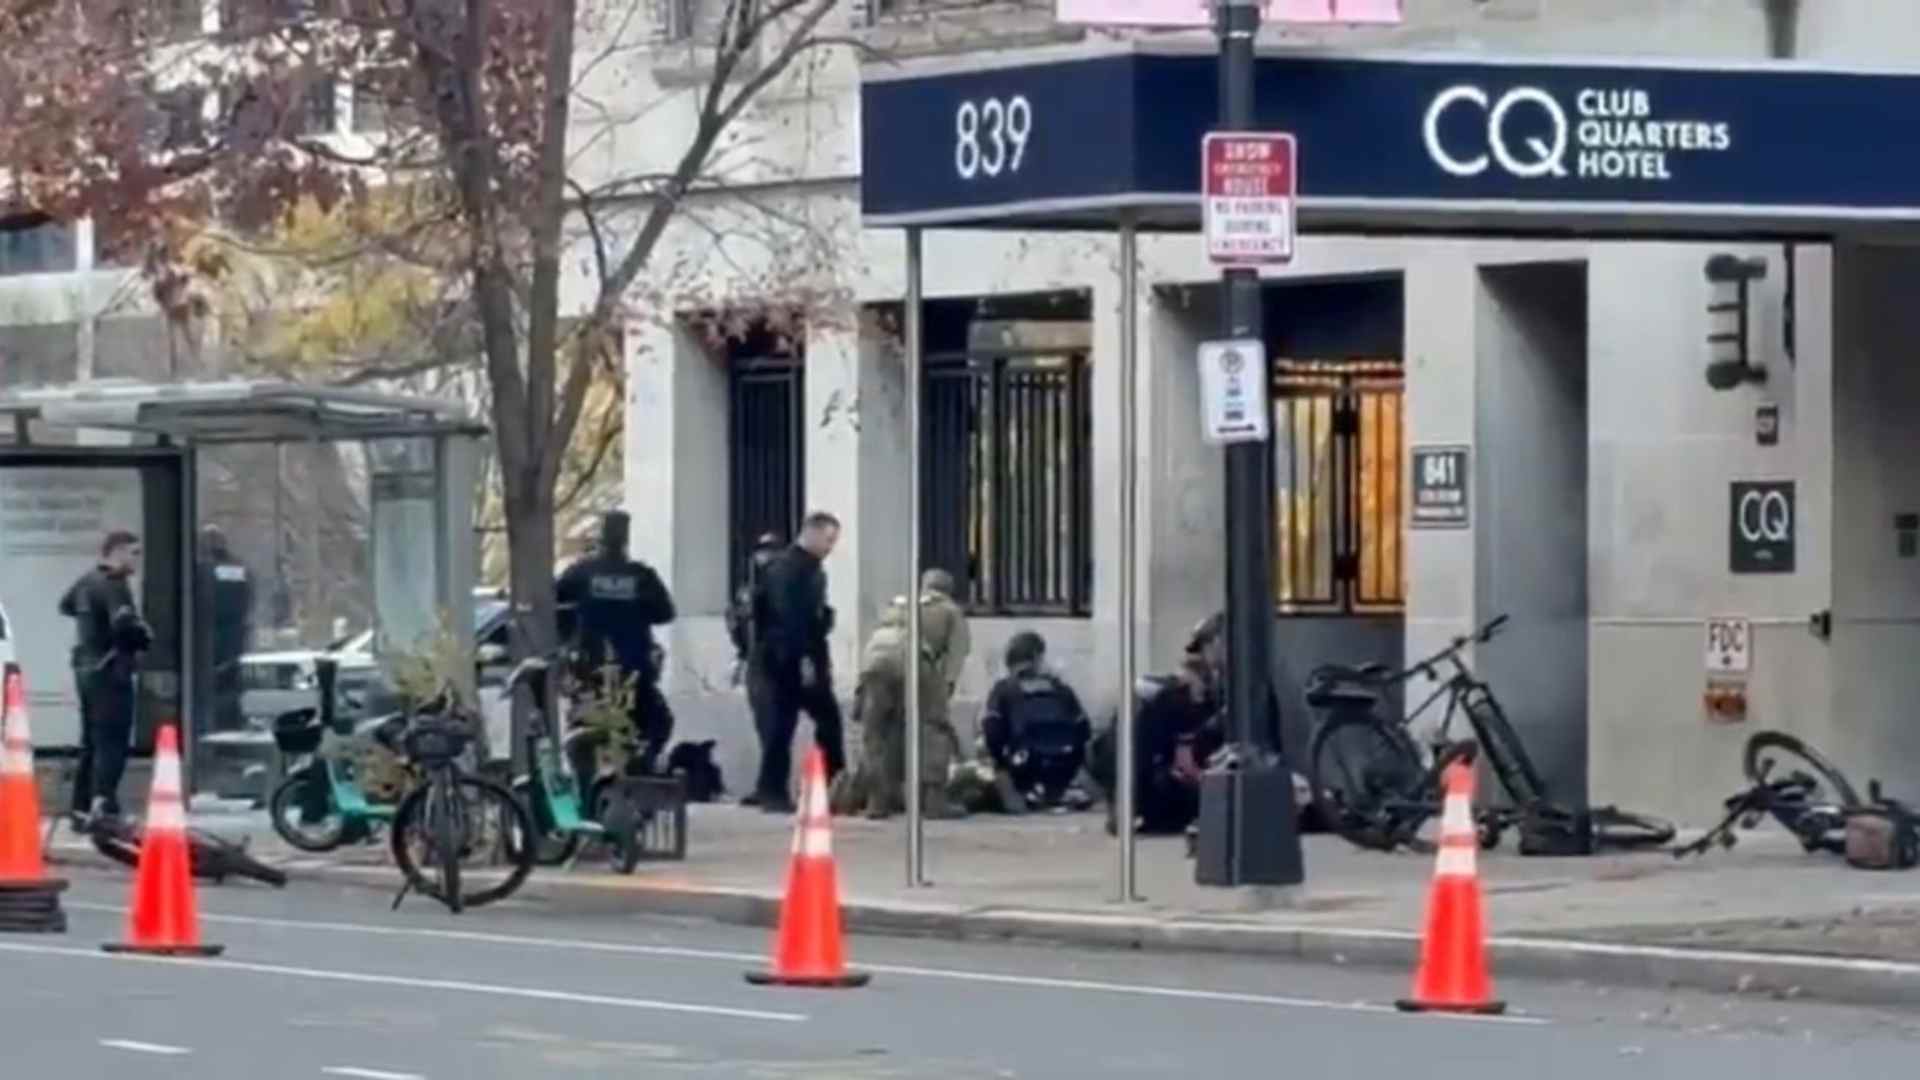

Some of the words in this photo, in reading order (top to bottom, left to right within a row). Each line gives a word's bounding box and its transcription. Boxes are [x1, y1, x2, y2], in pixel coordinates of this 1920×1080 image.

[1577, 88, 1650, 117] CLUB
[955, 95, 1031, 178] 839
[1424, 86, 1567, 176] CQ
[1577, 120, 1730, 150] QUARTERS
[1578, 151, 1671, 179] HOTEL
[1739, 490, 1788, 541] CQ
[1709, 622, 1743, 652] FDC
